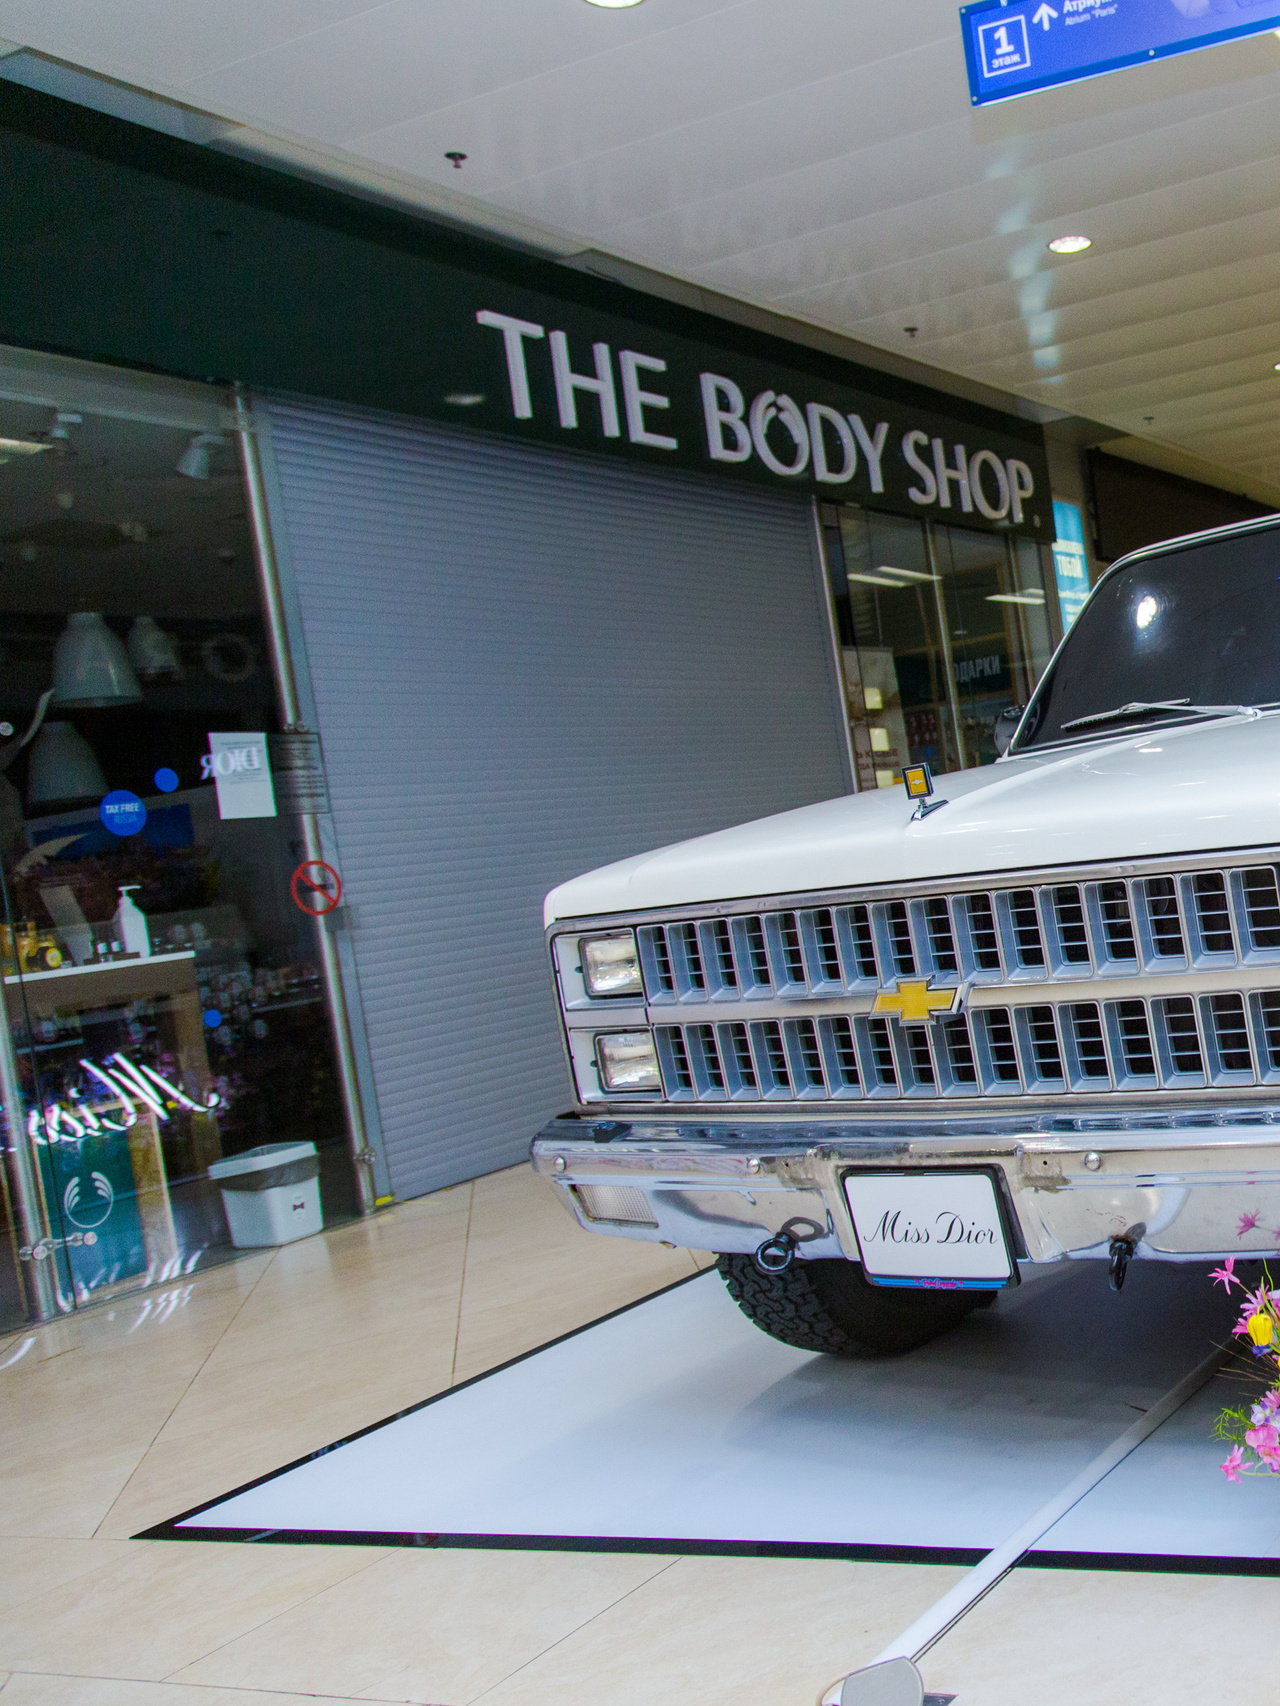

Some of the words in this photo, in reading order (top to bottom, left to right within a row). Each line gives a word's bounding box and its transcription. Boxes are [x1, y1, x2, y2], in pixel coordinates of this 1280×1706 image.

[1065, 12, 1091, 26] Atrium
[994, 26, 1014, 55] 1
[991, 53, 1021, 69] этаж
[476, 310, 678, 450] THE
[700, 372, 889, 493] BODY
[902, 430, 1034, 524] SHOP
[953, 655, 1001, 683] ОДАРКИ
[105, 804, 119, 813] TAX
[120, 802, 140, 812] FREE
[864, 1210, 930, 1244] Miss
[935, 1211, 998, 1244] Dior
